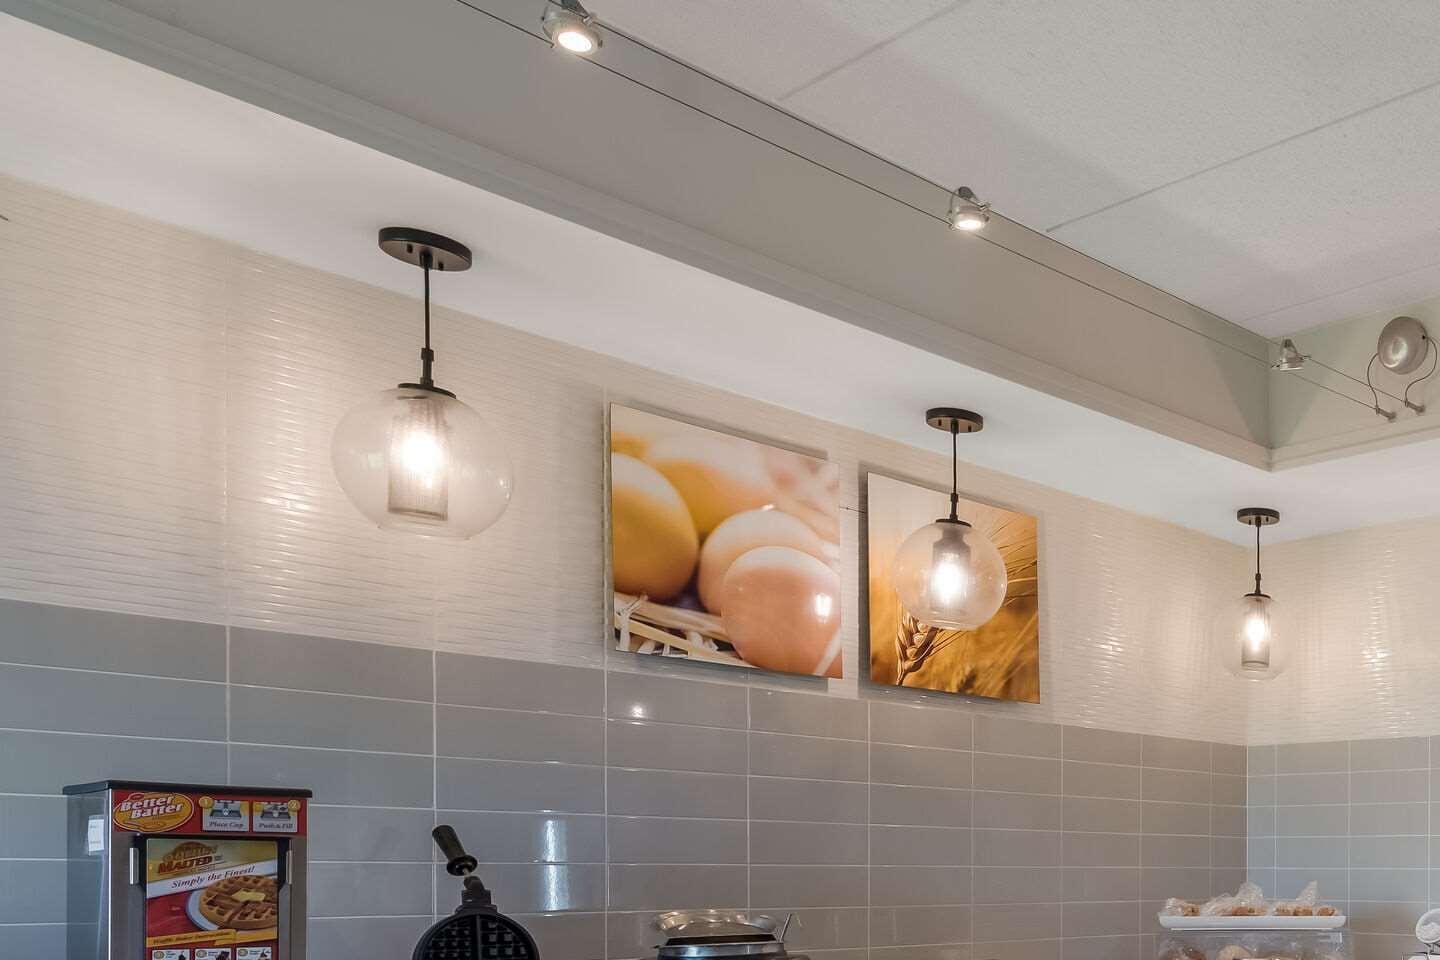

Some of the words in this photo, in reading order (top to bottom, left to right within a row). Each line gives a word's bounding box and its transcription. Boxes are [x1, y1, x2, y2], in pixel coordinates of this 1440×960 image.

[119, 795, 173, 812] Better
[130, 803, 184, 820] Batter
[171, 876, 205, 889] Simply
[207, 872, 222, 881] the
[224, 865, 256, 879] Finest!
